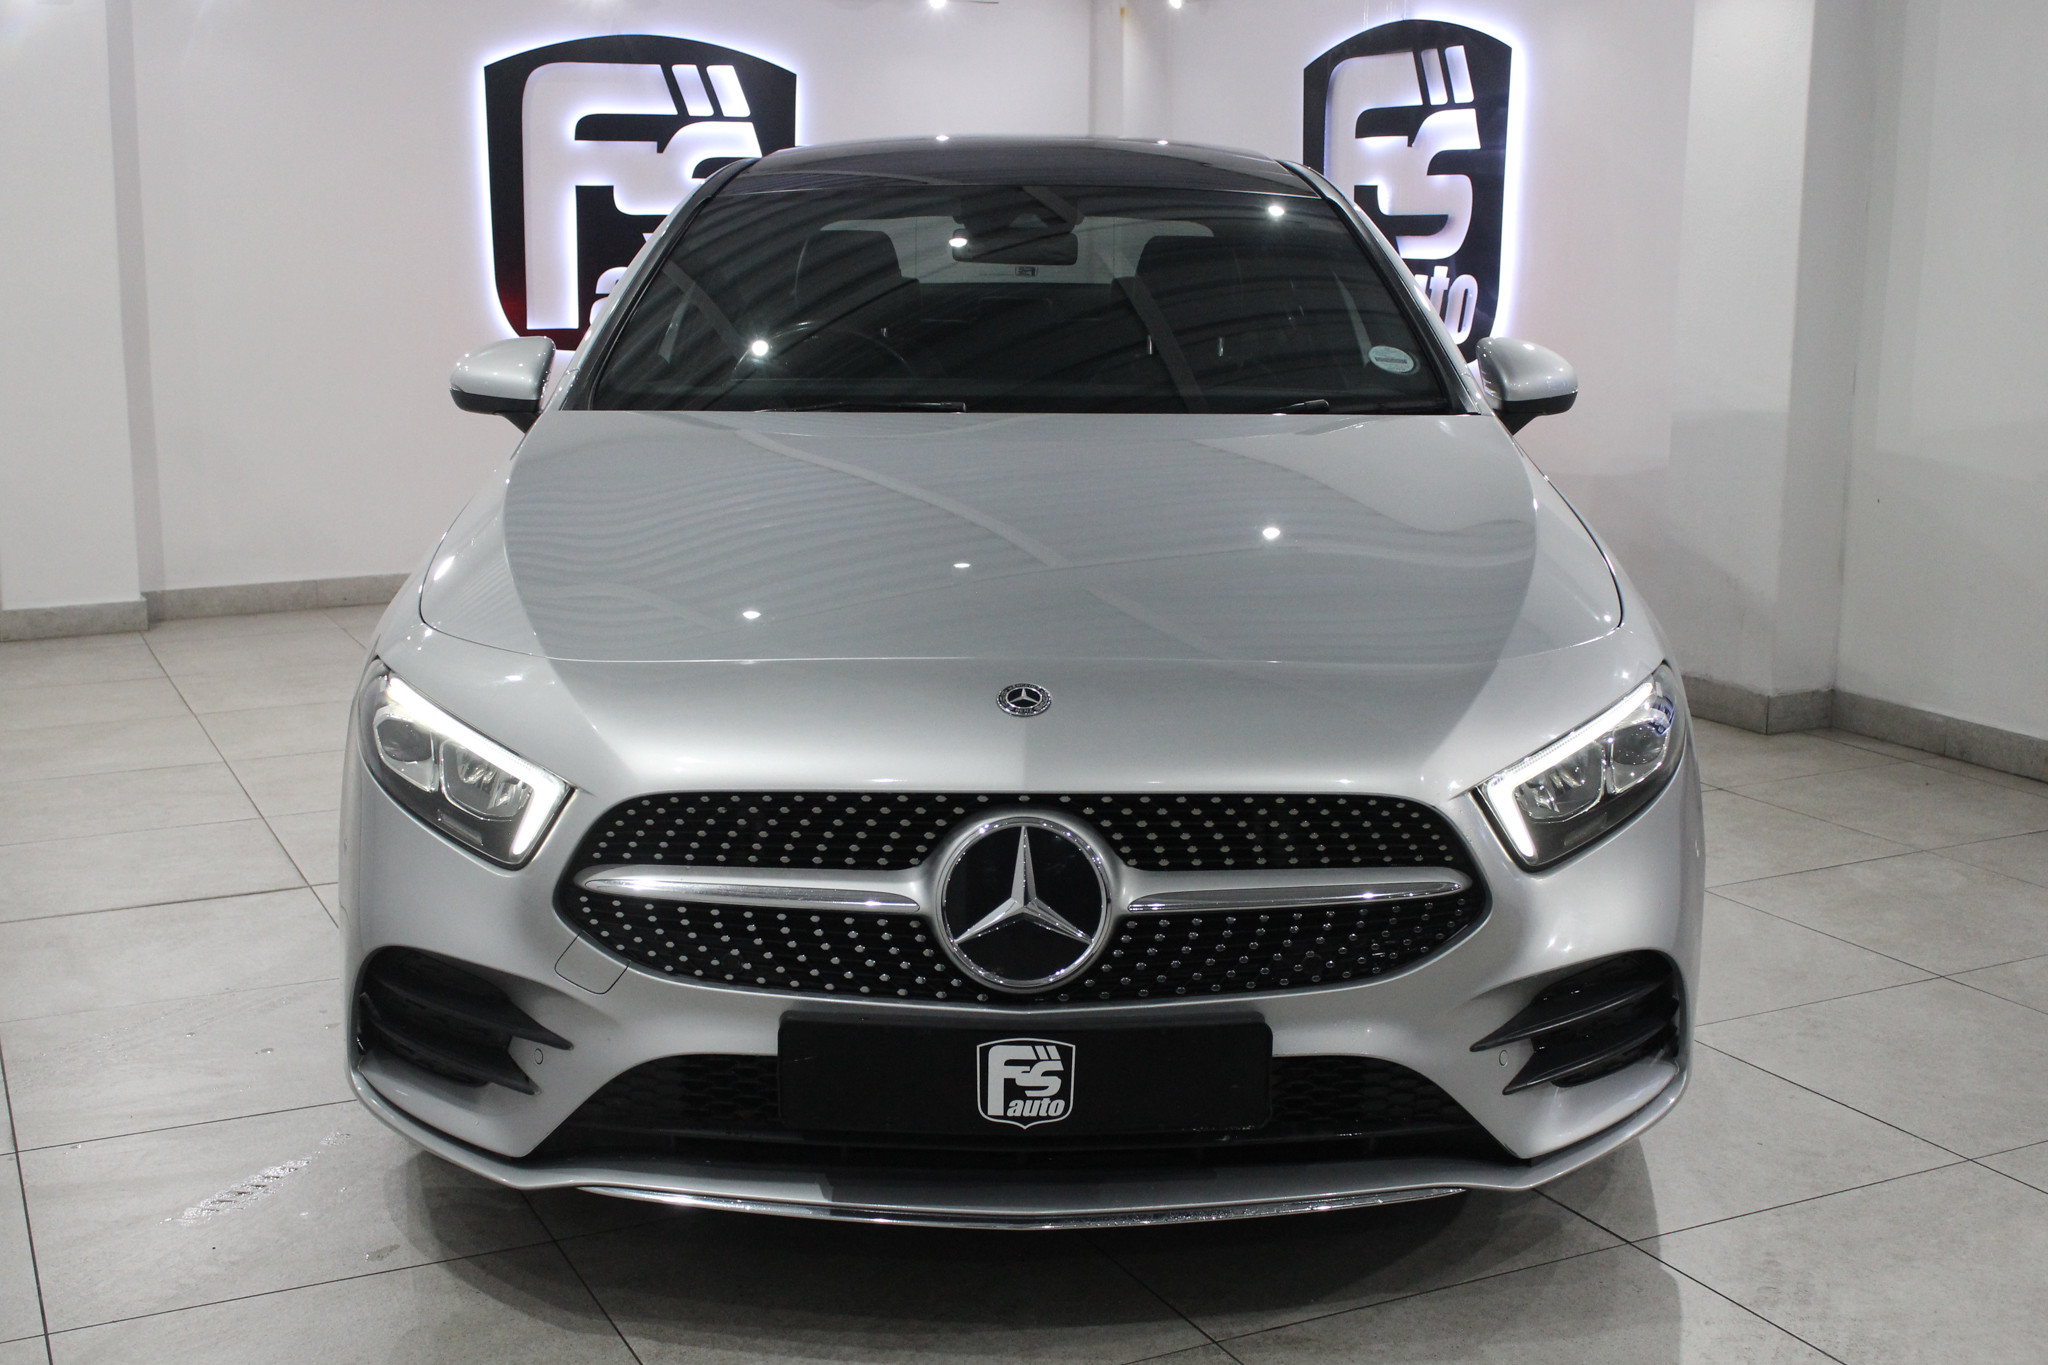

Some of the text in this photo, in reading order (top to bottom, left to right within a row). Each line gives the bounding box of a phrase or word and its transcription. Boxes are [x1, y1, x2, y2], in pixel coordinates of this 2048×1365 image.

[1414, 265, 1478, 345] to
[987, 1045, 1064, 1116] FS
[1006, 1098, 1066, 1117] auto
